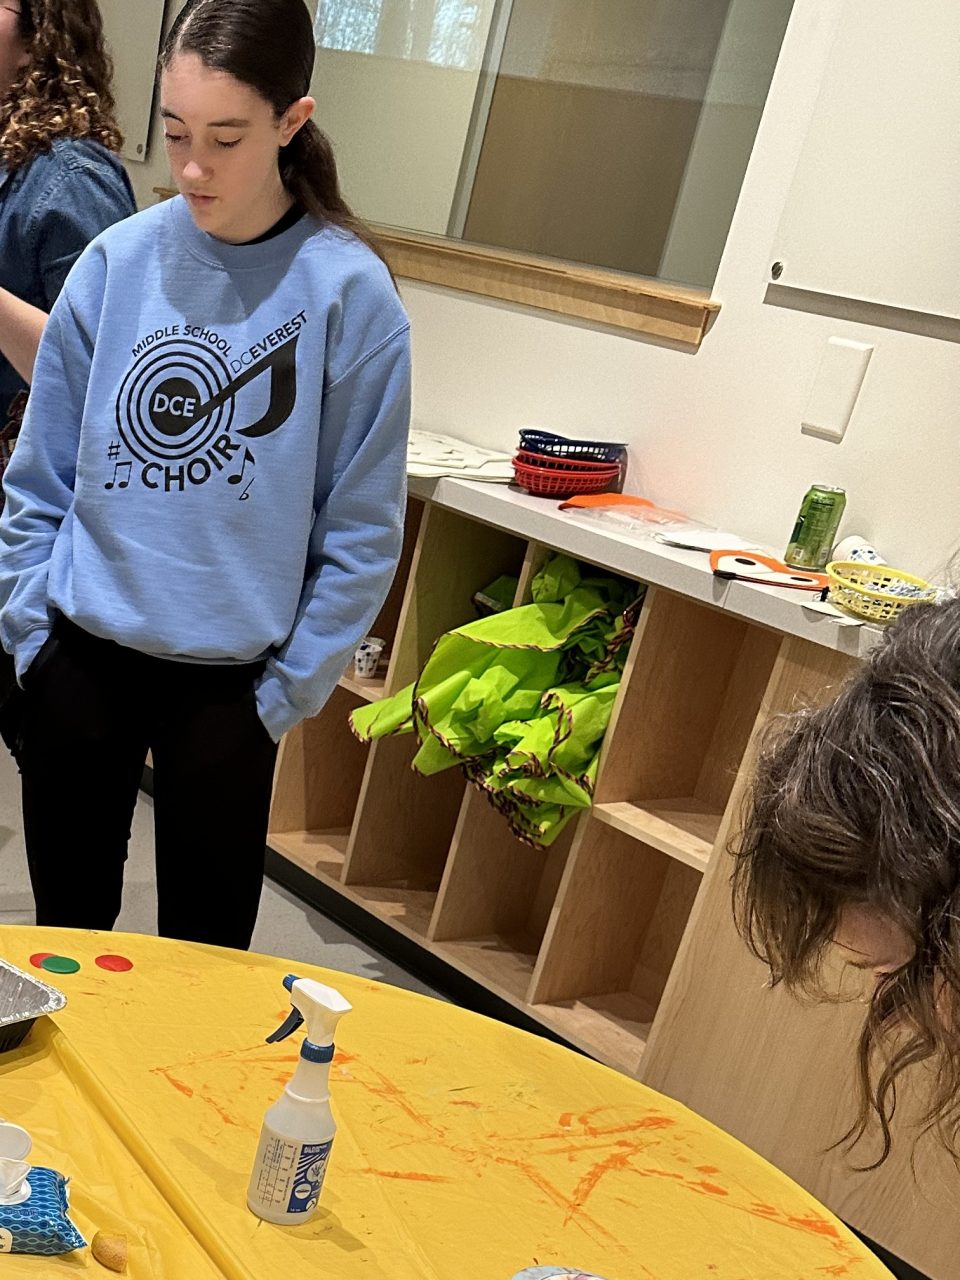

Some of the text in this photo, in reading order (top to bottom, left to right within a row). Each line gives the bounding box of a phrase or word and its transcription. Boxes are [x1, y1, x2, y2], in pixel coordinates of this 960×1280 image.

[132, 324, 233, 358] MIDDLE SCHOOL
[230, 310, 308, 374] DCEVEREST
[152, 392, 197, 418] DCE
[141, 433, 242, 492] CHOIR
